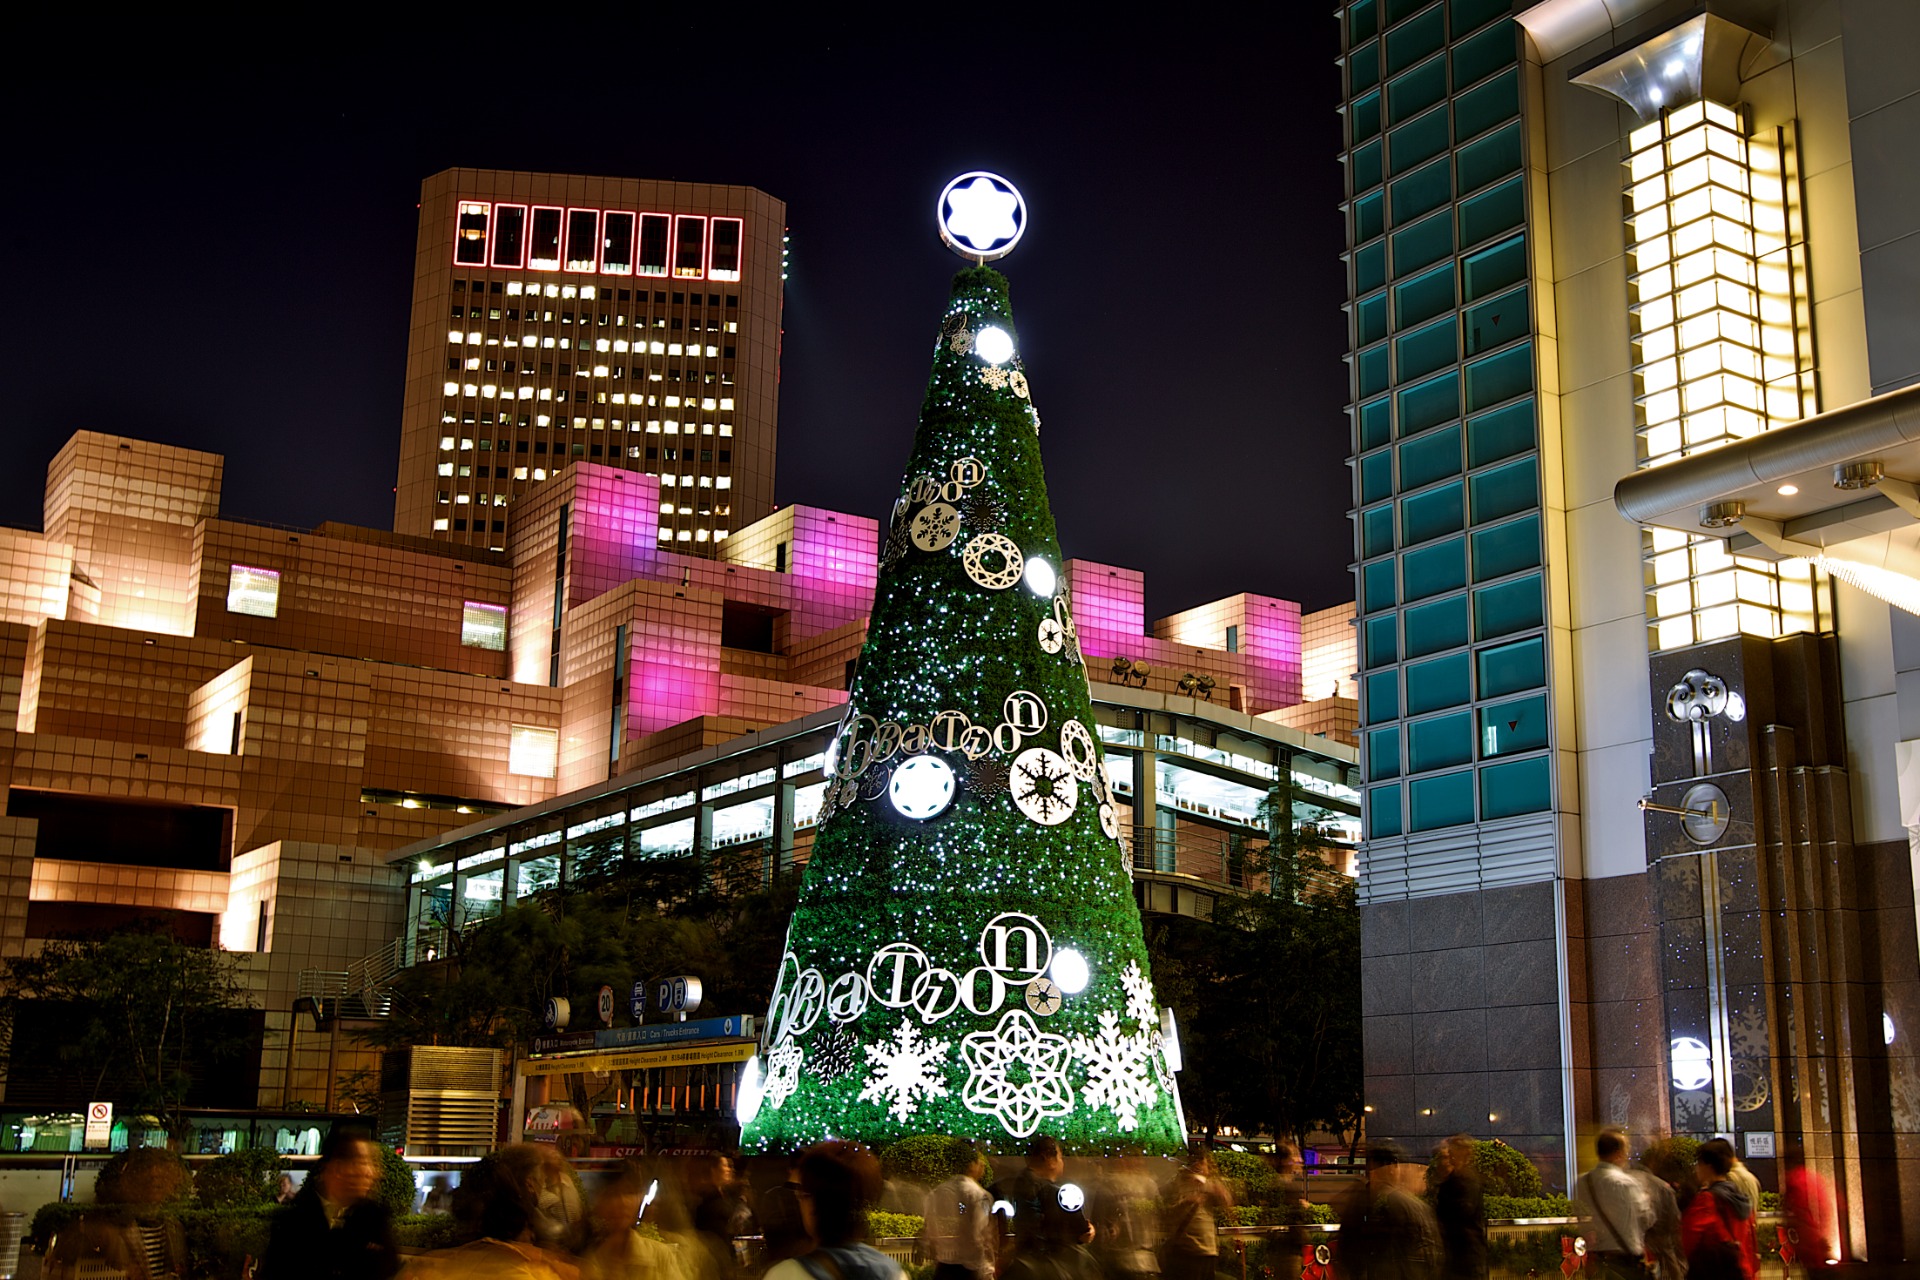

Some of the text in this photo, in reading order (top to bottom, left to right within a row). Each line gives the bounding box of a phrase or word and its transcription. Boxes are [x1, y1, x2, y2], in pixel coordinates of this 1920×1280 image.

[659, 984, 668, 1008] P
[601, 994, 610, 1012] 20
[678, 1027, 700, 1036] Entrance
[578, 1037, 595, 1045] Entrance
